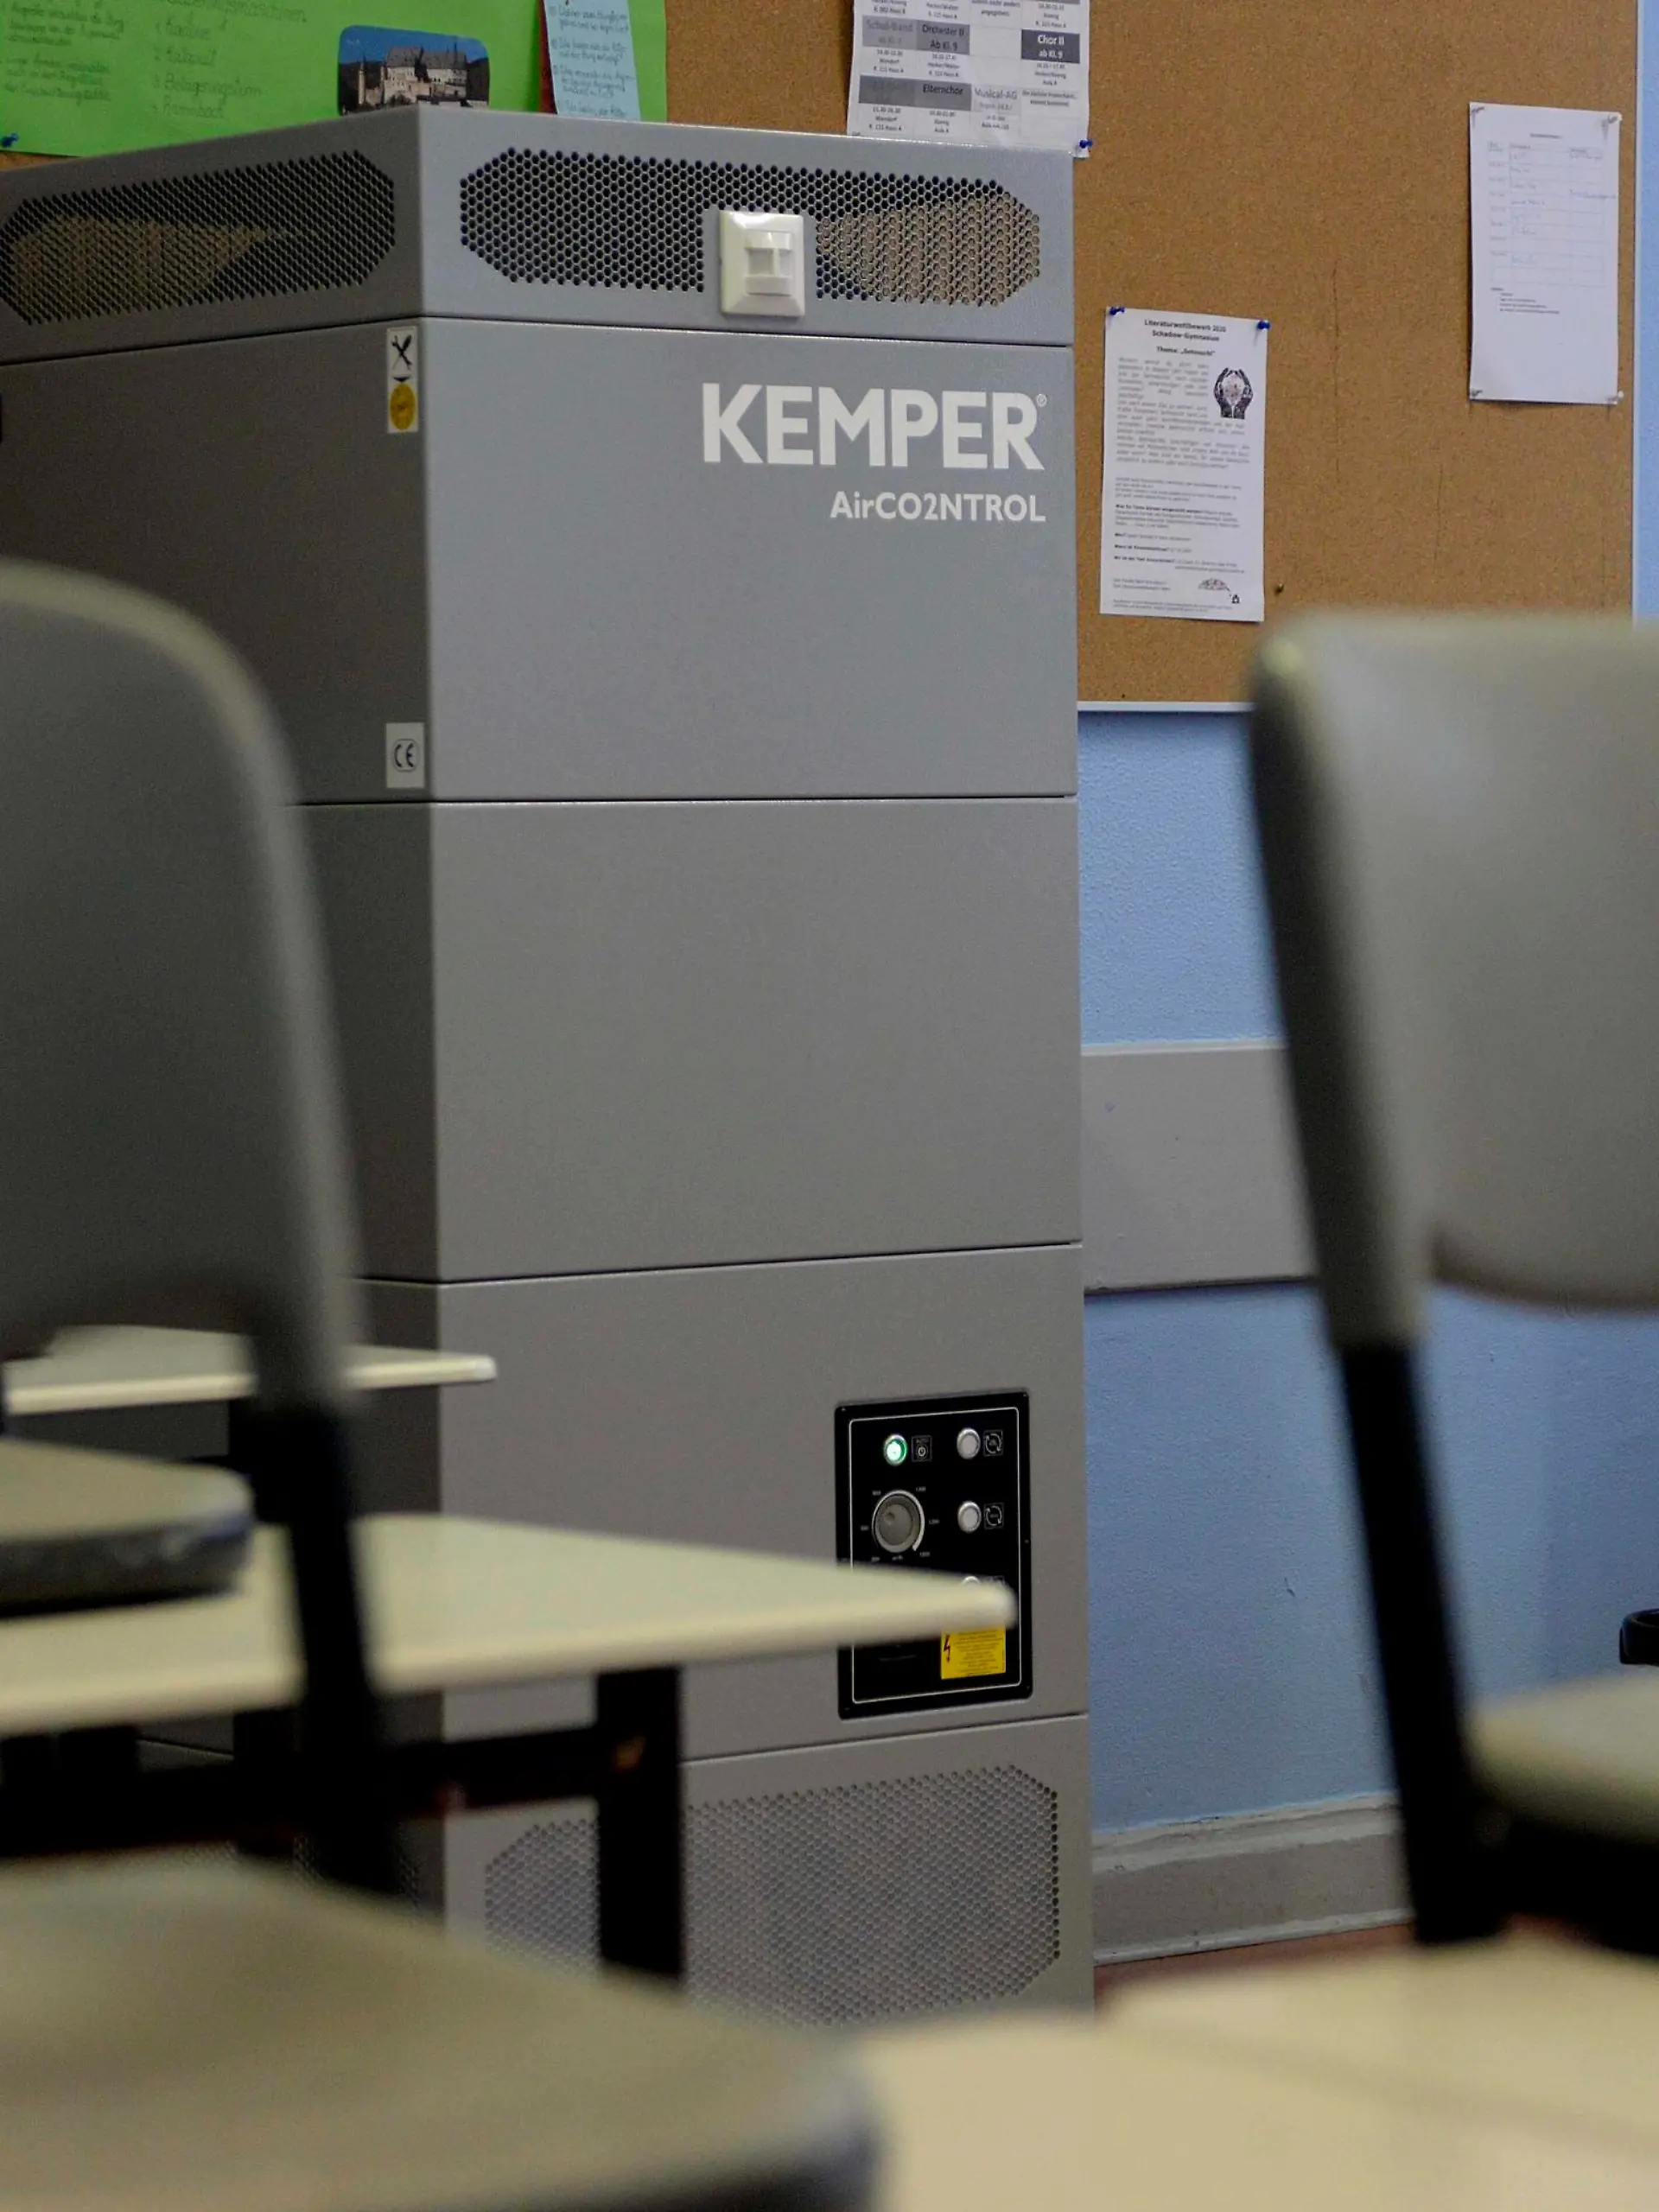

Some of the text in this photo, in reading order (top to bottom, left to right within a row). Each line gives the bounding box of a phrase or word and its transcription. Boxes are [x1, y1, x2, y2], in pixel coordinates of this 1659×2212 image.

[1038, 35, 1057, 45] Chor
[923, 84, 963, 95] Elternchor
[702, 382, 1046, 471] KEMPER
[830, 490, 1047, 524] AirCO2NTROL
